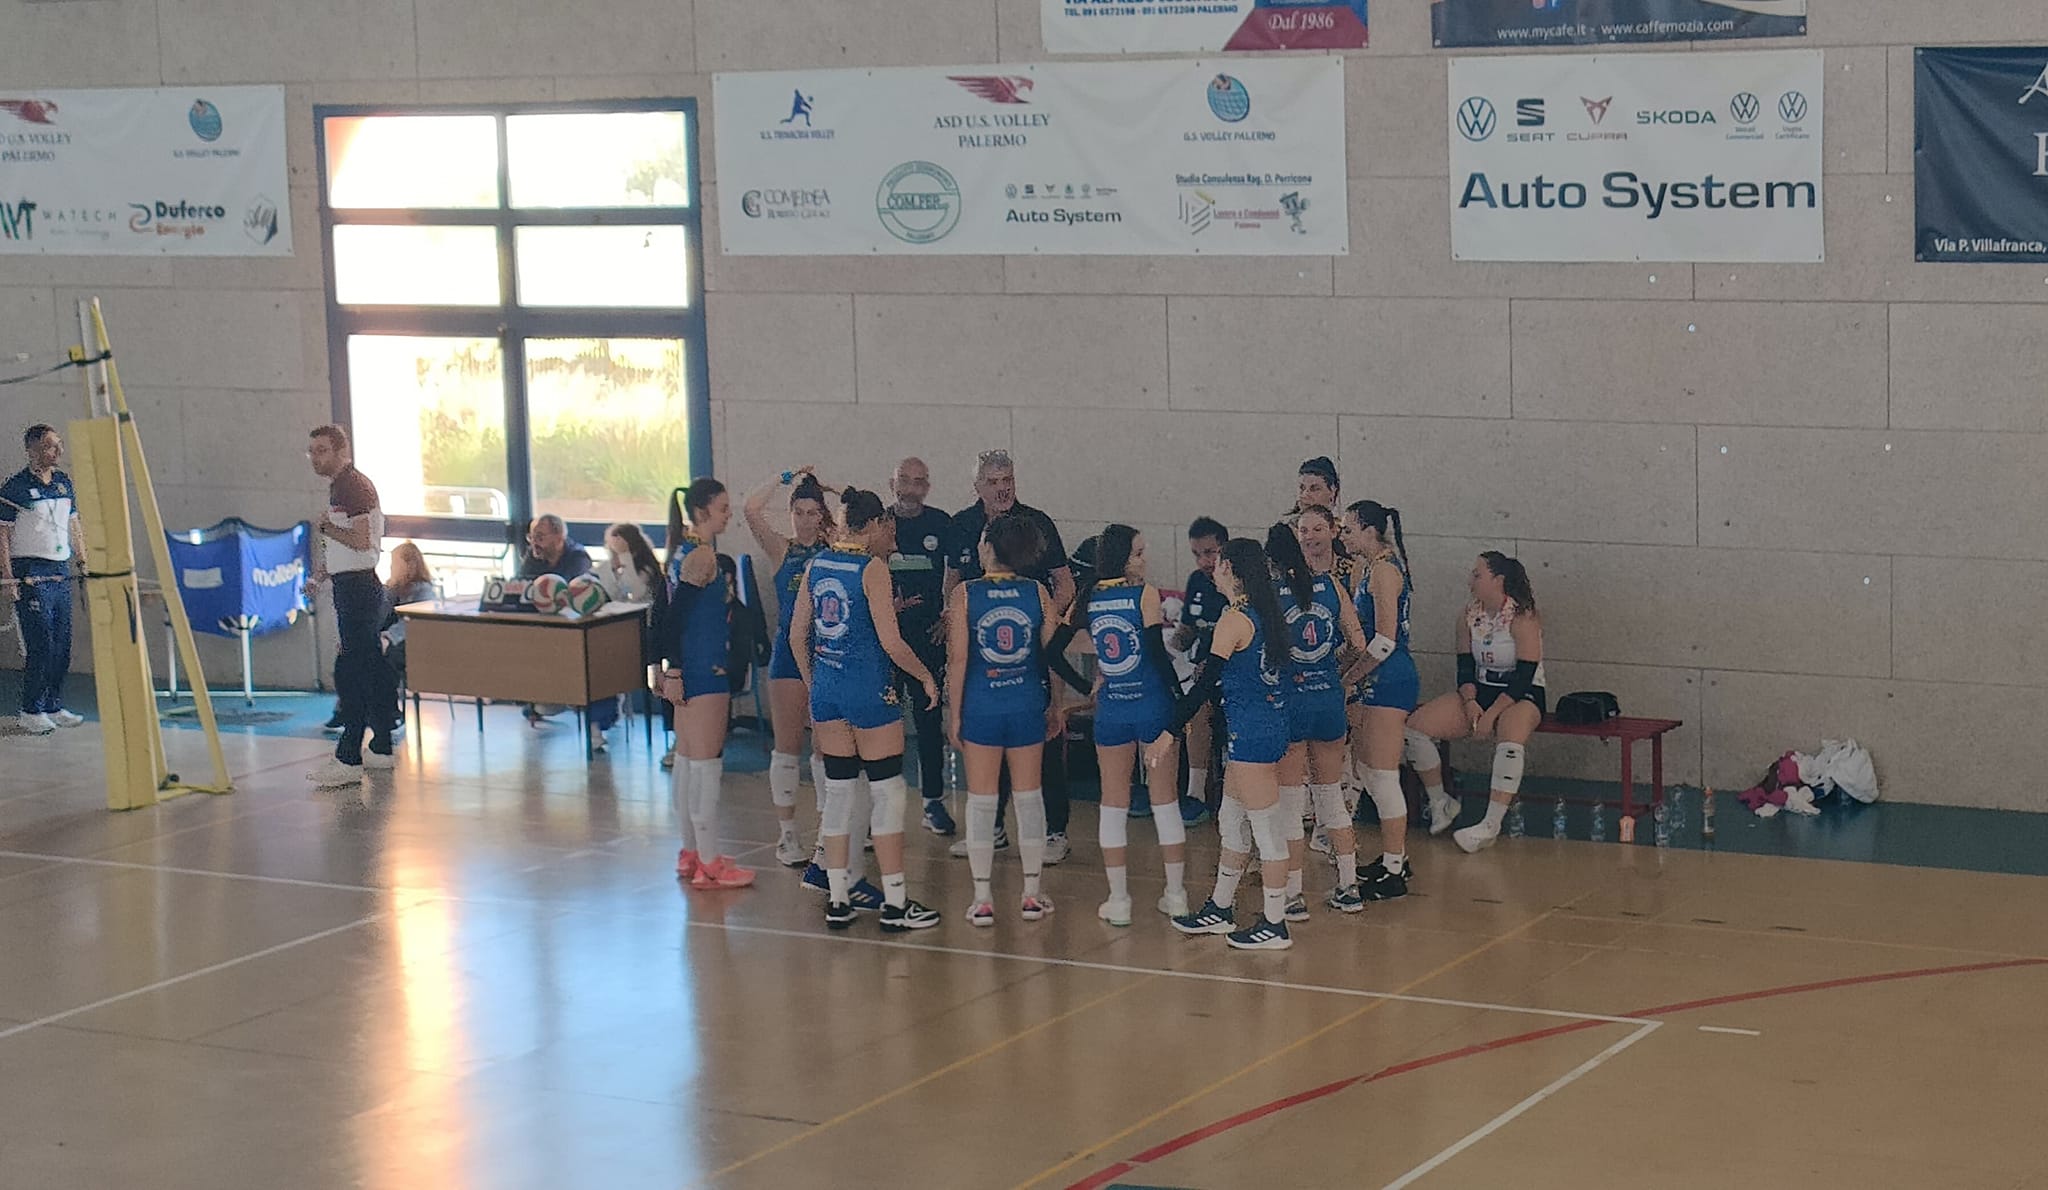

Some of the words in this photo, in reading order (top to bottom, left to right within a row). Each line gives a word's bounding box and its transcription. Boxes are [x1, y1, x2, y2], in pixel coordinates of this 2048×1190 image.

[1197, 5, 1239, 14] PALERMO
[1268, 10, 1299, 30] Dal
[1300, 11, 1335, 30] 1986
[1496, 23, 1587, 40] www.mycafe.it
[1600, 19, 1735, 35] www.caffemozia.com
[934, 115, 962, 128] ASD
[992, 113, 1050, 127] VOLLEY
[958, 133, 1028, 148] PALERMO
[1234, 130, 1276, 141] PALERMO
[1506, 132, 1556, 142] SEAT
[1566, 132, 1628, 141] CUPRA
[2, 150, 56, 161] PALERMO
[1176, 173, 1200, 183] Studio
[1458, 172, 1588, 209] Auto
[1602, 171, 1816, 219] System
[155, 201, 226, 219] Duferco
[1006, 209, 1049, 222] Auto
[1053, 208, 1122, 226] System
[1935, 238, 1956, 252] Via
[1958, 239, 1969, 252] P.
[1971, 238, 2047, 254] Villafranca,
[996, 625, 1014, 651] 9
[1302, 620, 1318, 646] 4
[1103, 632, 1121, 659] 3
